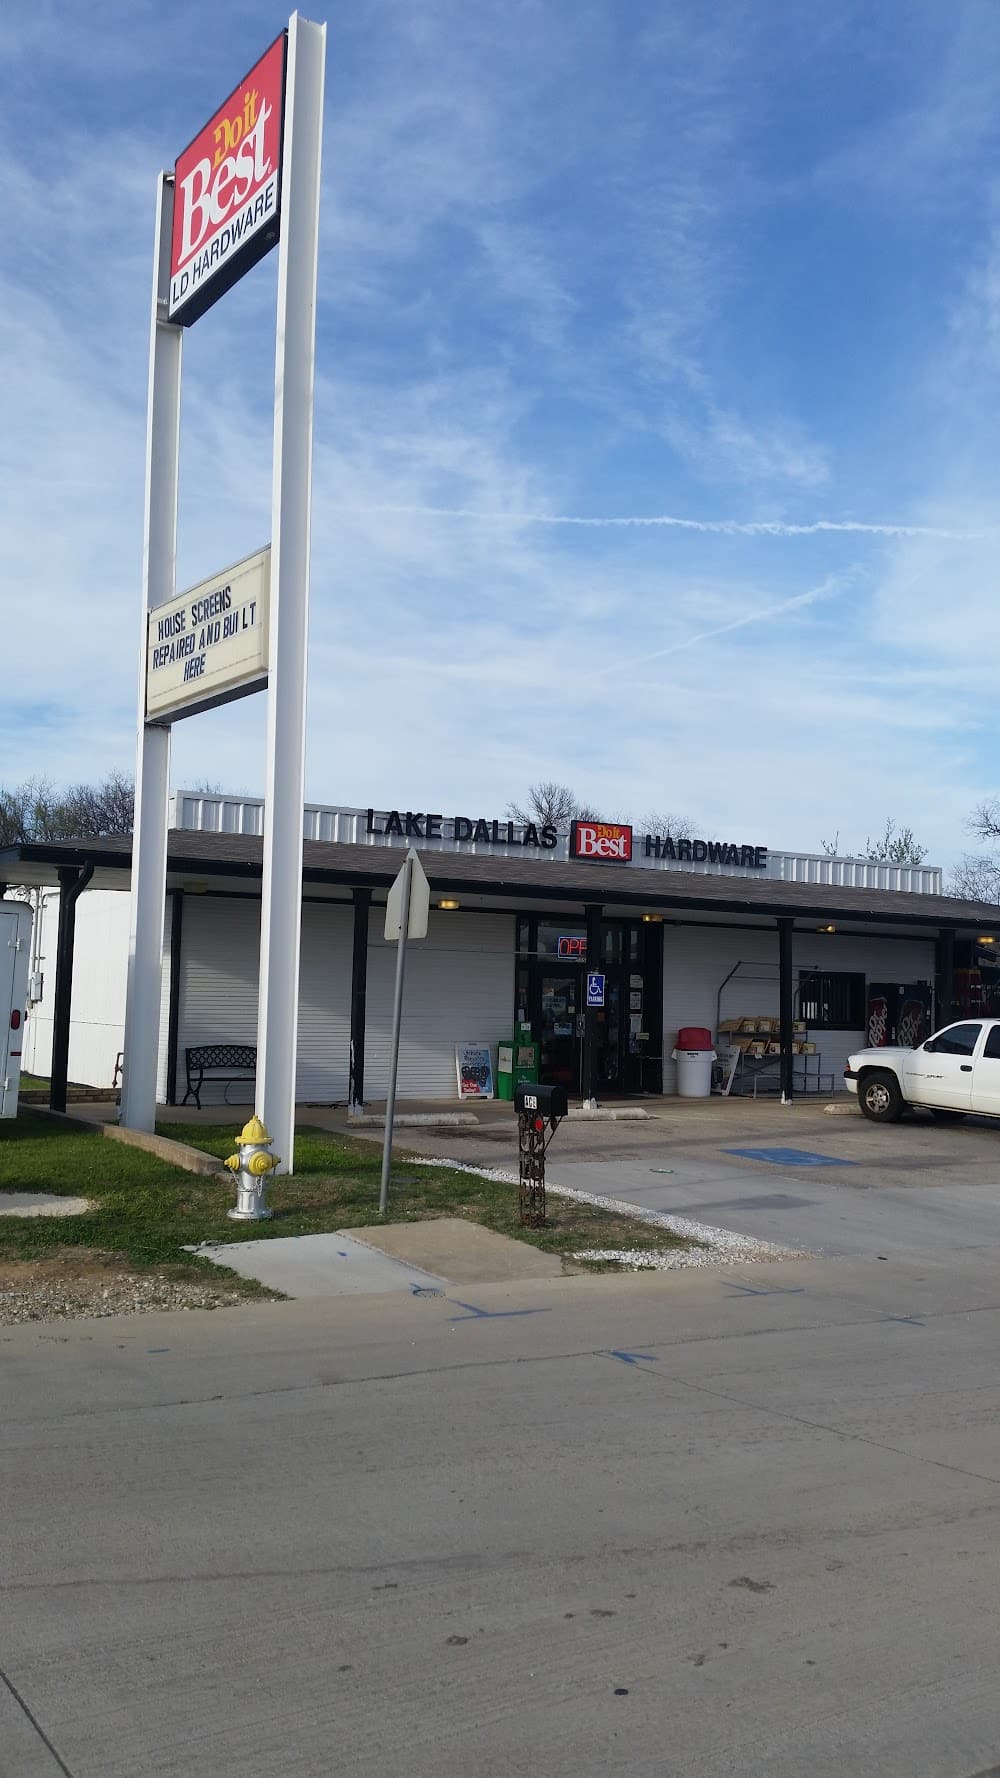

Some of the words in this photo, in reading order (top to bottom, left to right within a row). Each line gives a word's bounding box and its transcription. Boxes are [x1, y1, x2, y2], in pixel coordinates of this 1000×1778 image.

[213, 116, 242, 171] Do
[243, 88, 259, 137] it
[177, 96, 273, 267] Best
[172, 271, 189, 305] LD
[192, 181, 275, 285] HARDWARE
[158, 610, 186, 642] HOUSE
[191, 585, 231, 627] SCREENS
[152, 633, 195, 670] REPAIRED
[198, 620, 221, 650] AND
[184, 653, 206, 682] HERE
[366, 808, 442, 840] LAKE
[454, 816, 558, 849] DALLAS
[578, 827, 627, 857] Best
[597, 824, 612, 839] Do
[612, 825, 620, 839] it
[645, 834, 768, 869] HARDWARE
[560, 938, 588, 956] OPE
